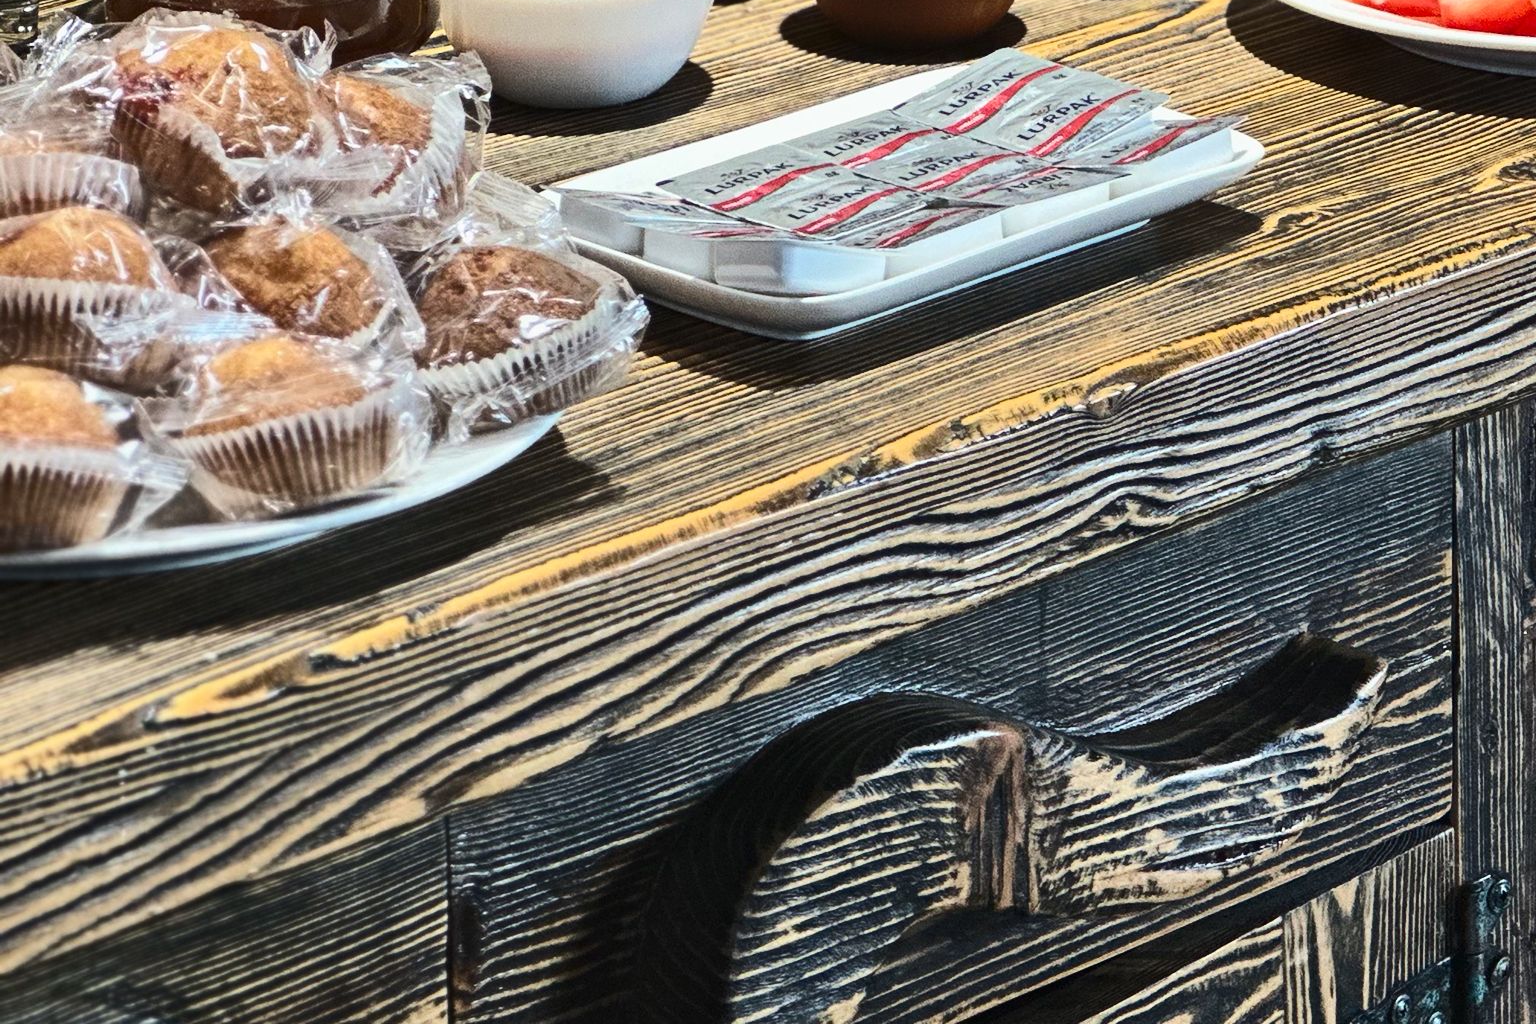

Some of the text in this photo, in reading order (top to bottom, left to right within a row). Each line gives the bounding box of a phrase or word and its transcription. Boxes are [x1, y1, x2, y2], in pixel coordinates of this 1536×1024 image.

[939, 70, 1021, 116] LURPAK
[1017, 92, 1101, 141] LURPAK
[823, 125, 907, 158] LURPAK
[704, 162, 795, 195] LURPAK
[898, 154, 978, 182] LURPAK
[787, 185, 869, 220] LURPAK
